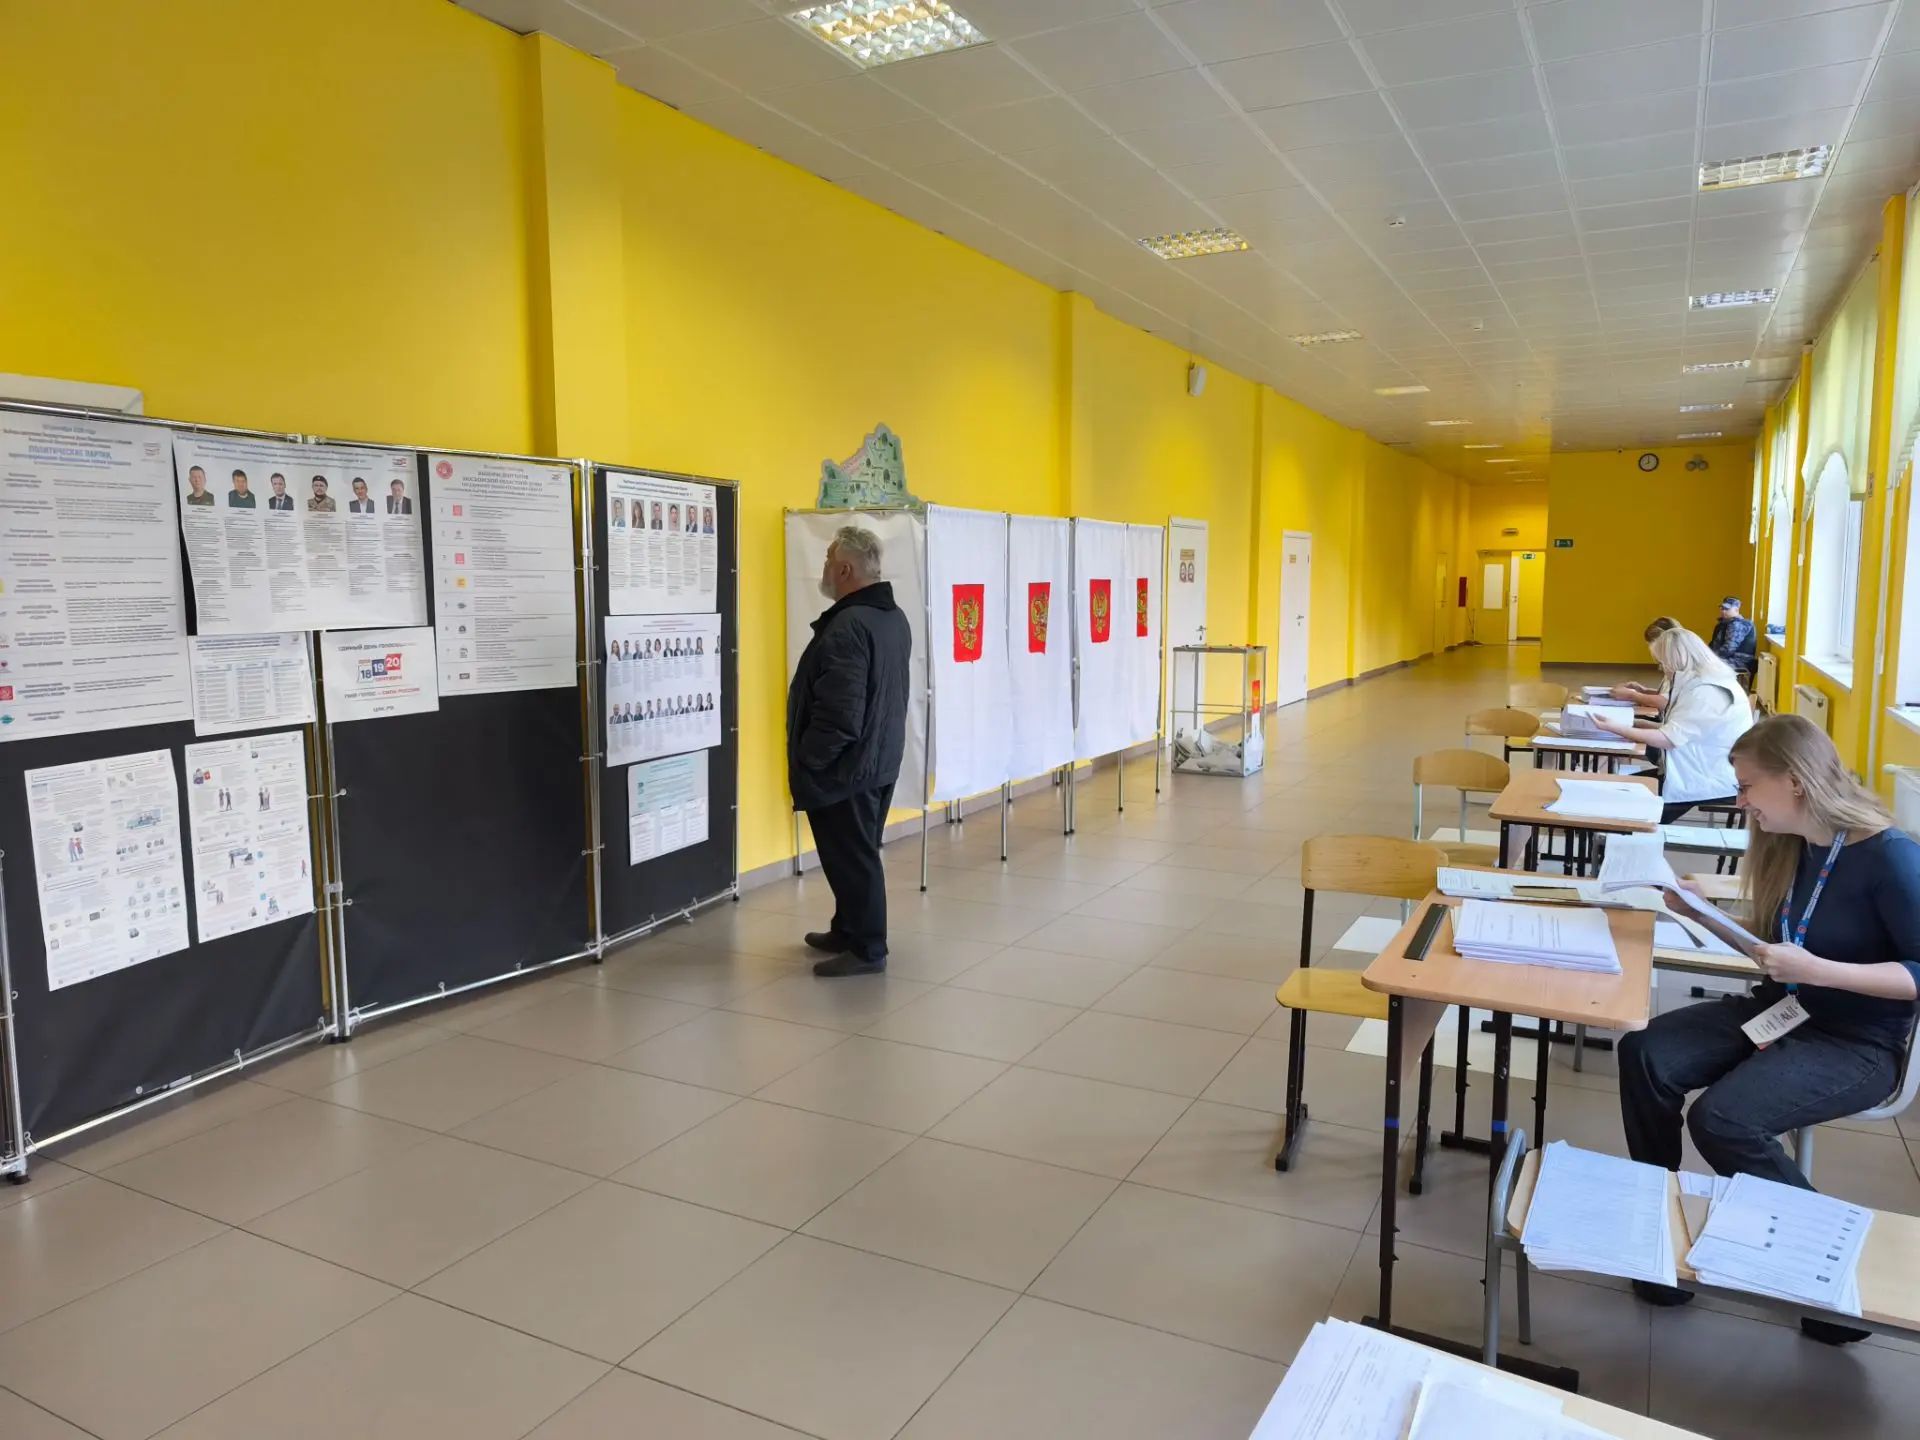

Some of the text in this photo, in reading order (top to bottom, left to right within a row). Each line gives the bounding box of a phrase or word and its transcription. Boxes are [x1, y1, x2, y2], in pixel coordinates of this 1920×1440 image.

[361, 657, 400, 679] 18 19 20
